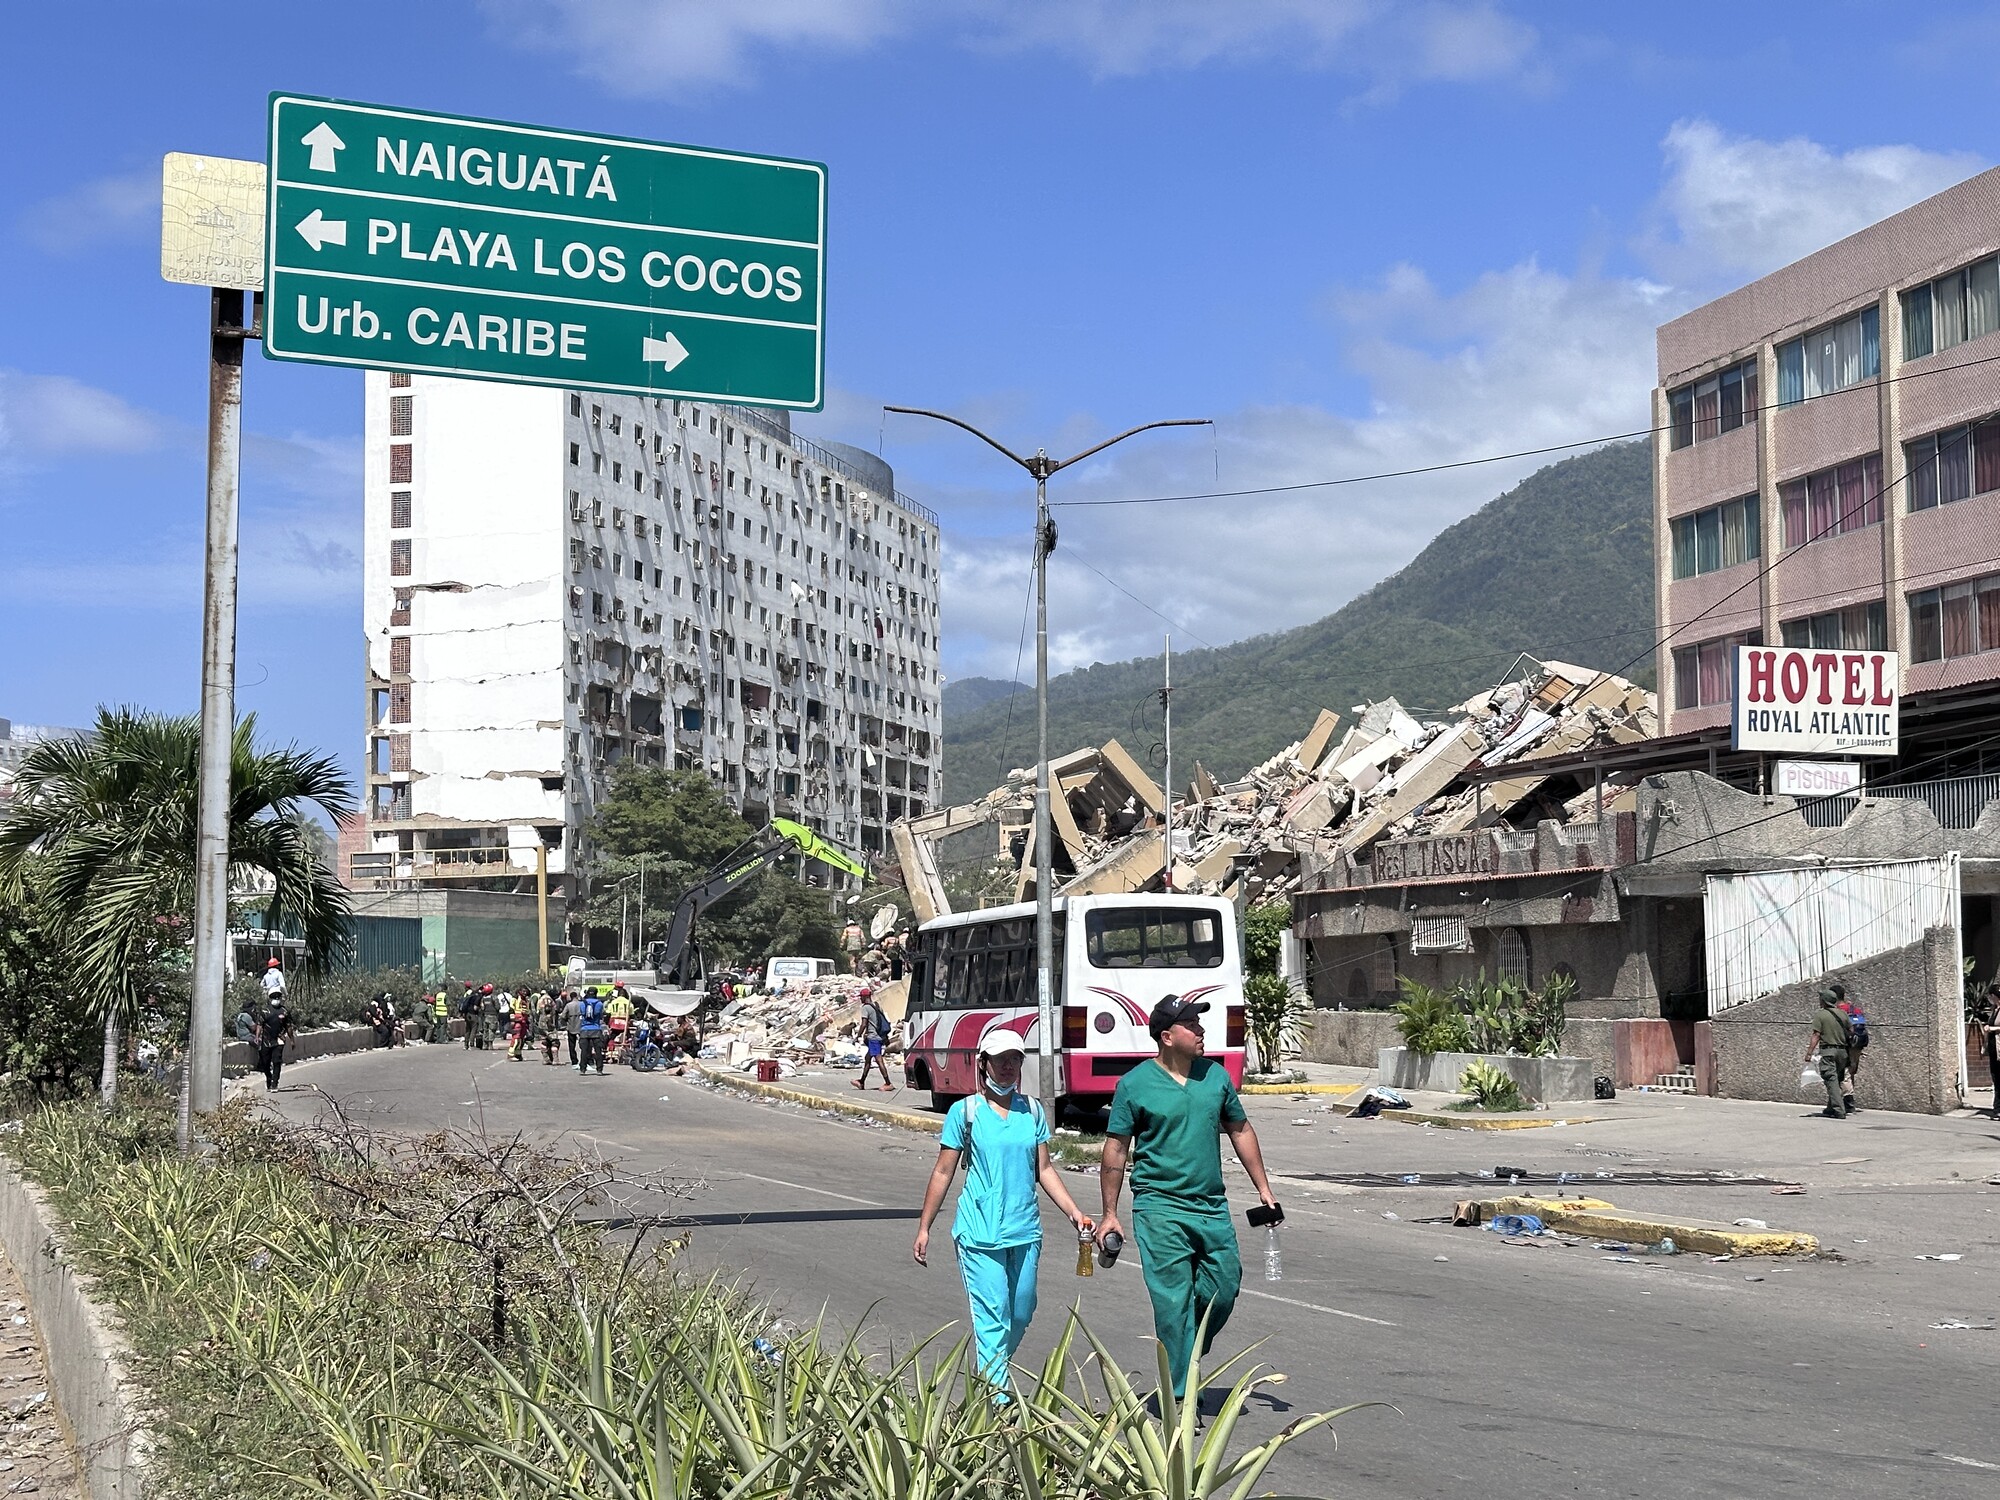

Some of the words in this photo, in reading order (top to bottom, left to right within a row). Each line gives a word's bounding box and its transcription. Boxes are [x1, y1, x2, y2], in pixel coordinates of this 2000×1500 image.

[377, 137, 617, 201] NAIGUATÁ
[368, 219, 518, 271] PLAYA
[534, 238, 626, 282] LOS
[642, 252, 802, 301] COCOS
[297, 295, 392, 340] Urb.
[407, 308, 587, 361] CARIBE
[1748, 651, 1893, 706] HOTEL
[1748, 709, 1802, 733] ROYAL
[1809, 711, 1890, 735] ATLANTIC
[1786, 769, 1850, 790] PISCINA
[725, 856, 764, 883] ZOOMLION
[1418, 834, 1481, 876] TASCA
